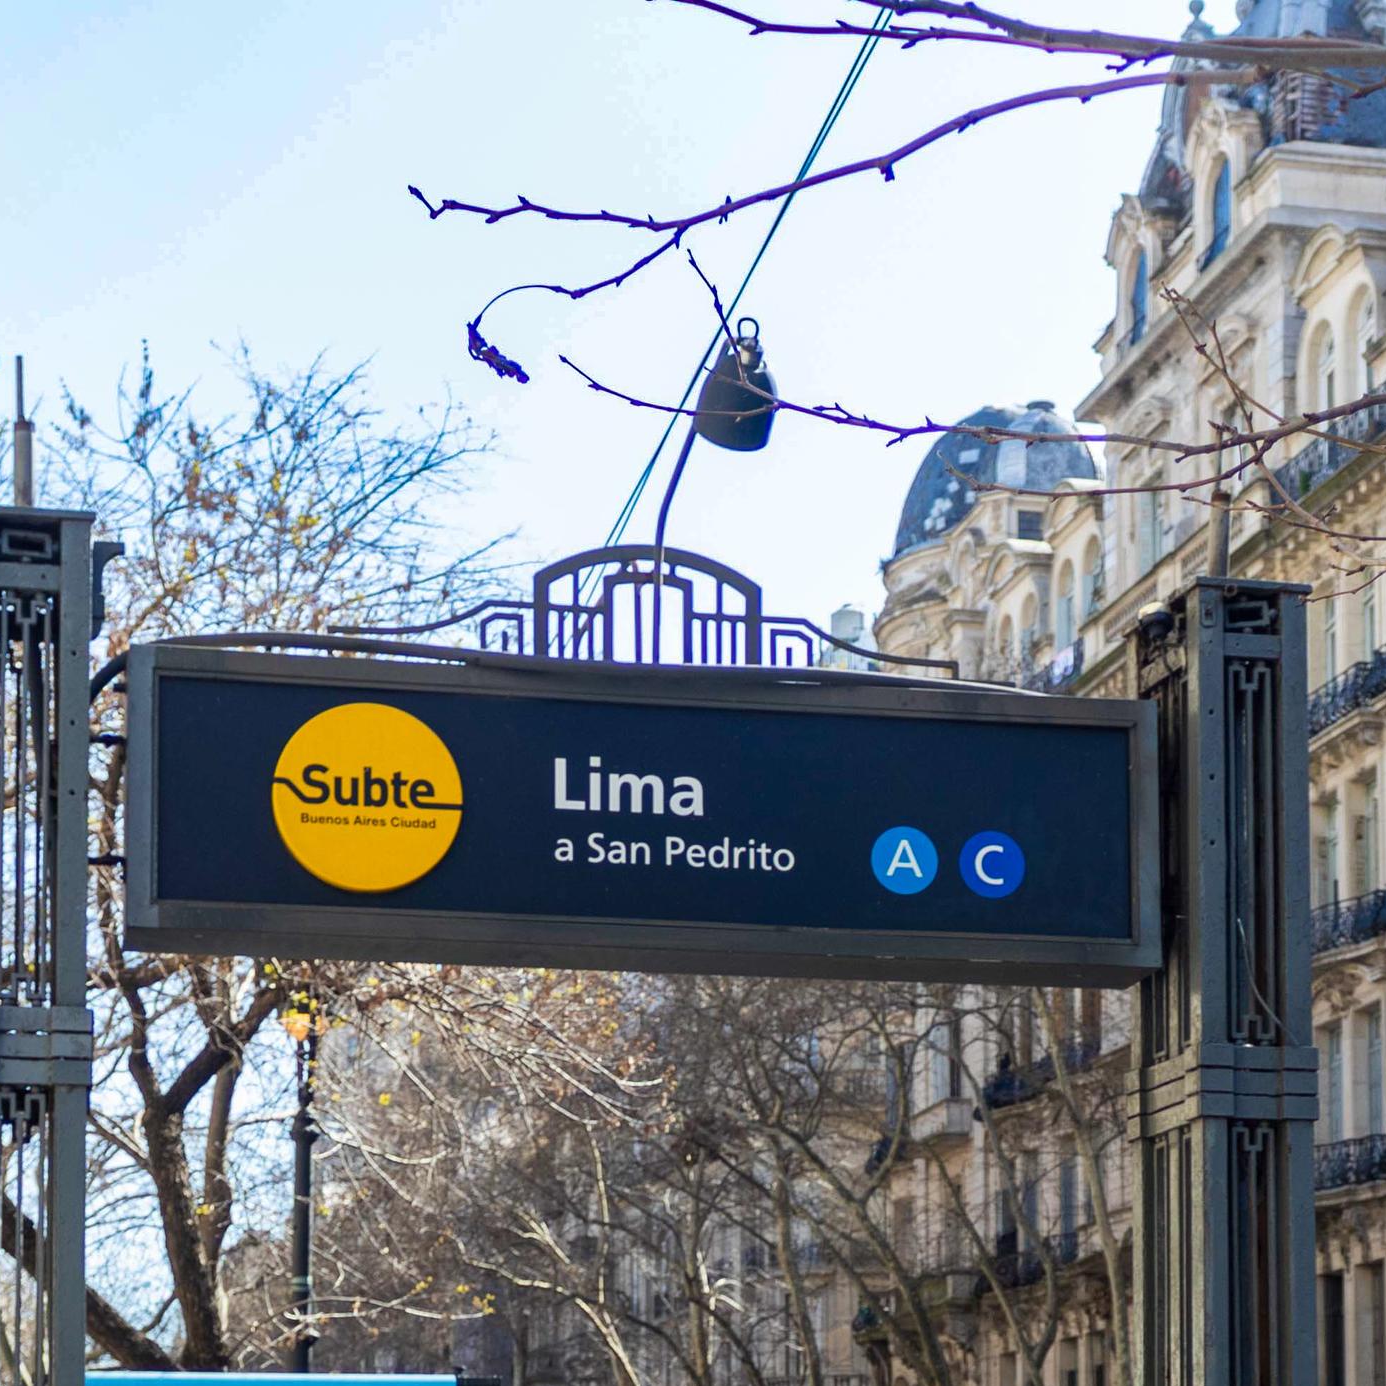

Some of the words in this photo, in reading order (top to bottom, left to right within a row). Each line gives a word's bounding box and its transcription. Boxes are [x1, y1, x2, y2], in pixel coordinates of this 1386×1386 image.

[295, 763, 443, 811] Subte
[553, 756, 704, 817] Lima
[300, 812, 350, 825] Buenos
[353, 815, 387, 827] Aires
[390, 816, 437, 829] Ciudad
[553, 838, 574, 863] a
[587, 833, 652, 866] San
[665, 837, 796, 872] Pedrito
[886, 838, 924, 878] A
[973, 845, 1005, 886] C
